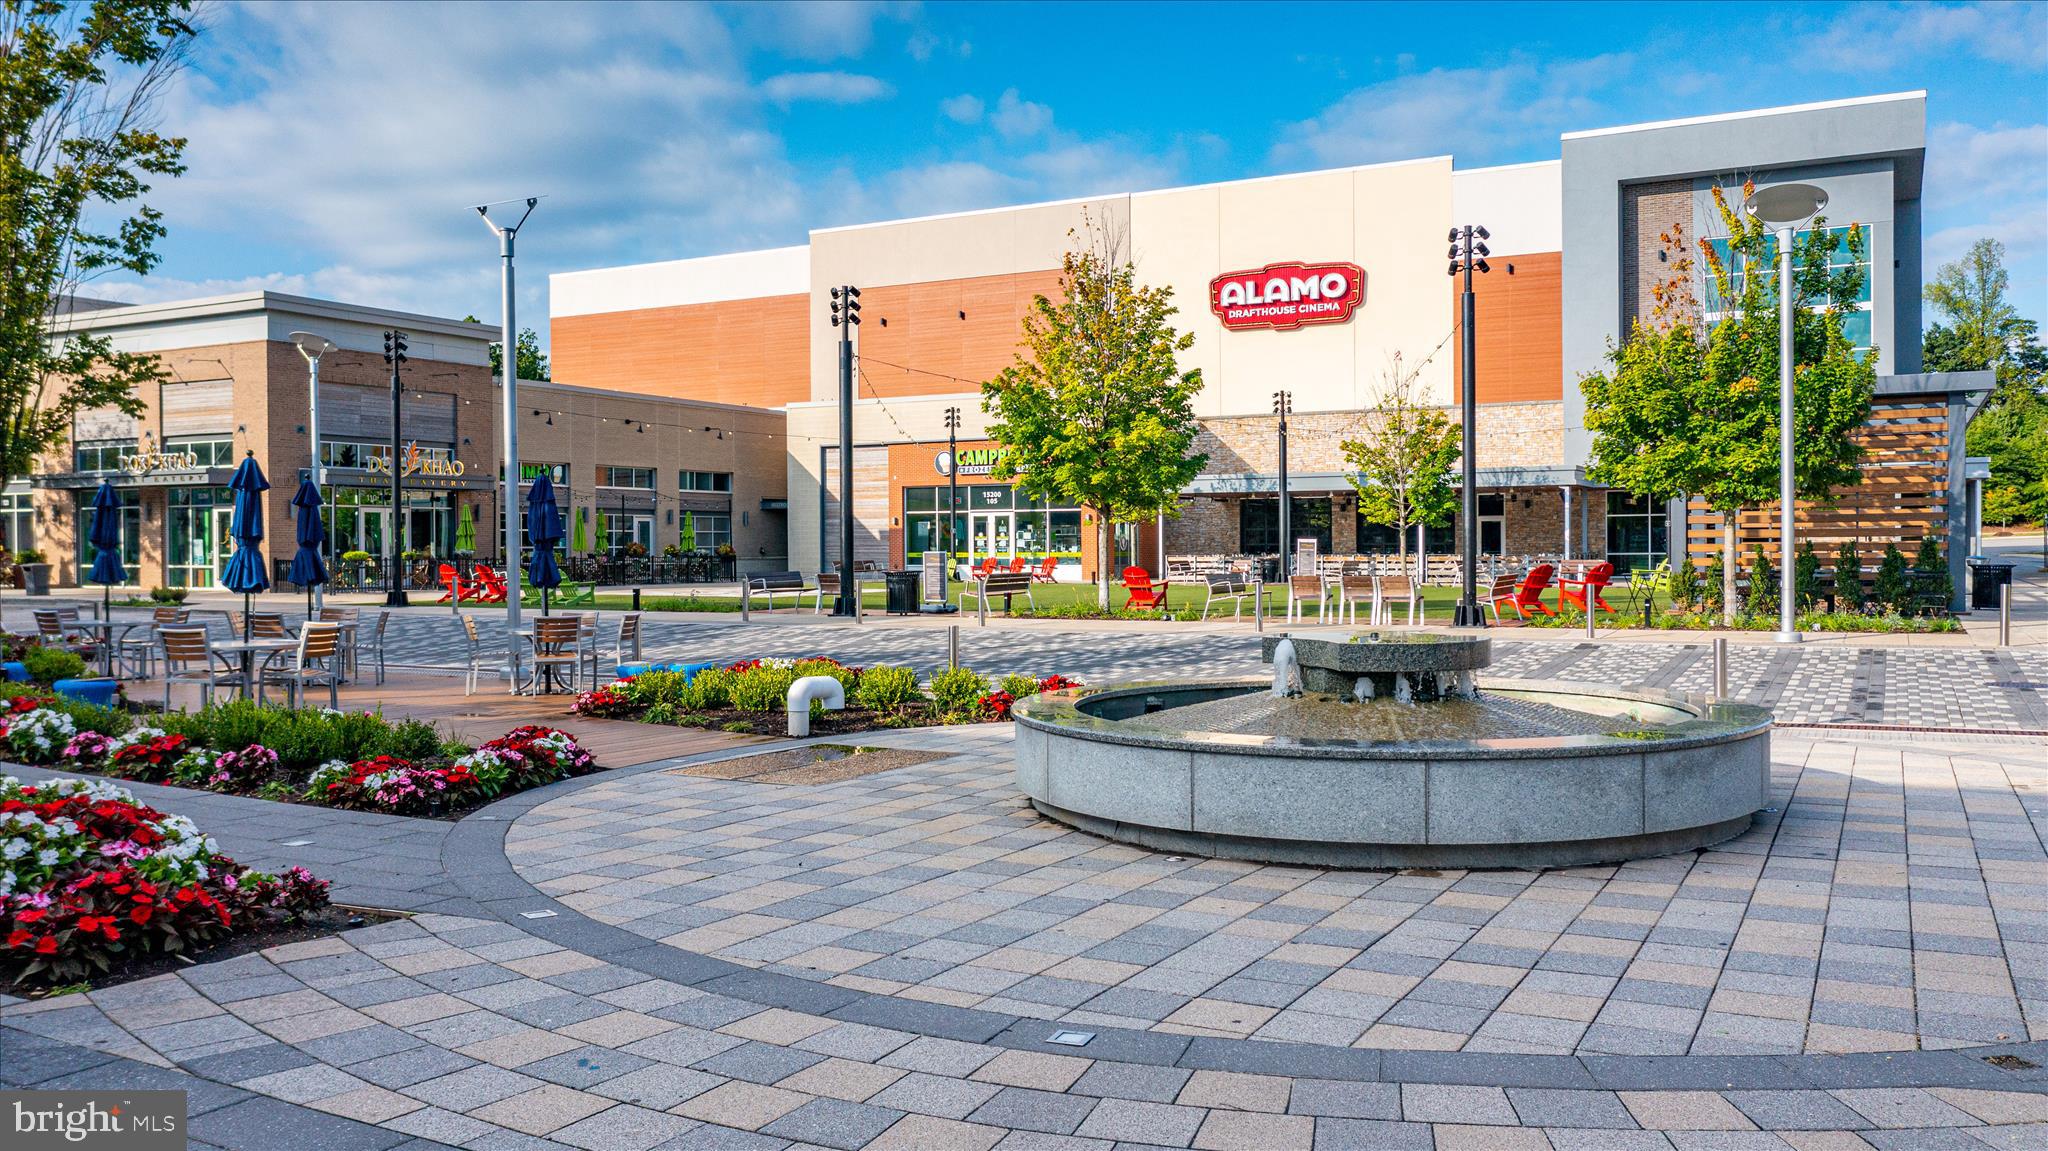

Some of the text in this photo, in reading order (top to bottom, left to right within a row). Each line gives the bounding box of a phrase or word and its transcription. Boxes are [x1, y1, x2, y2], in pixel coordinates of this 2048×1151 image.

[1220, 272, 1348, 307] ALAMO
[1228, 302, 1341, 319] DRAFTHOUSE CINEMA
[419, 459, 465, 477] KHAO
[409, 479, 468, 487] EATERY
